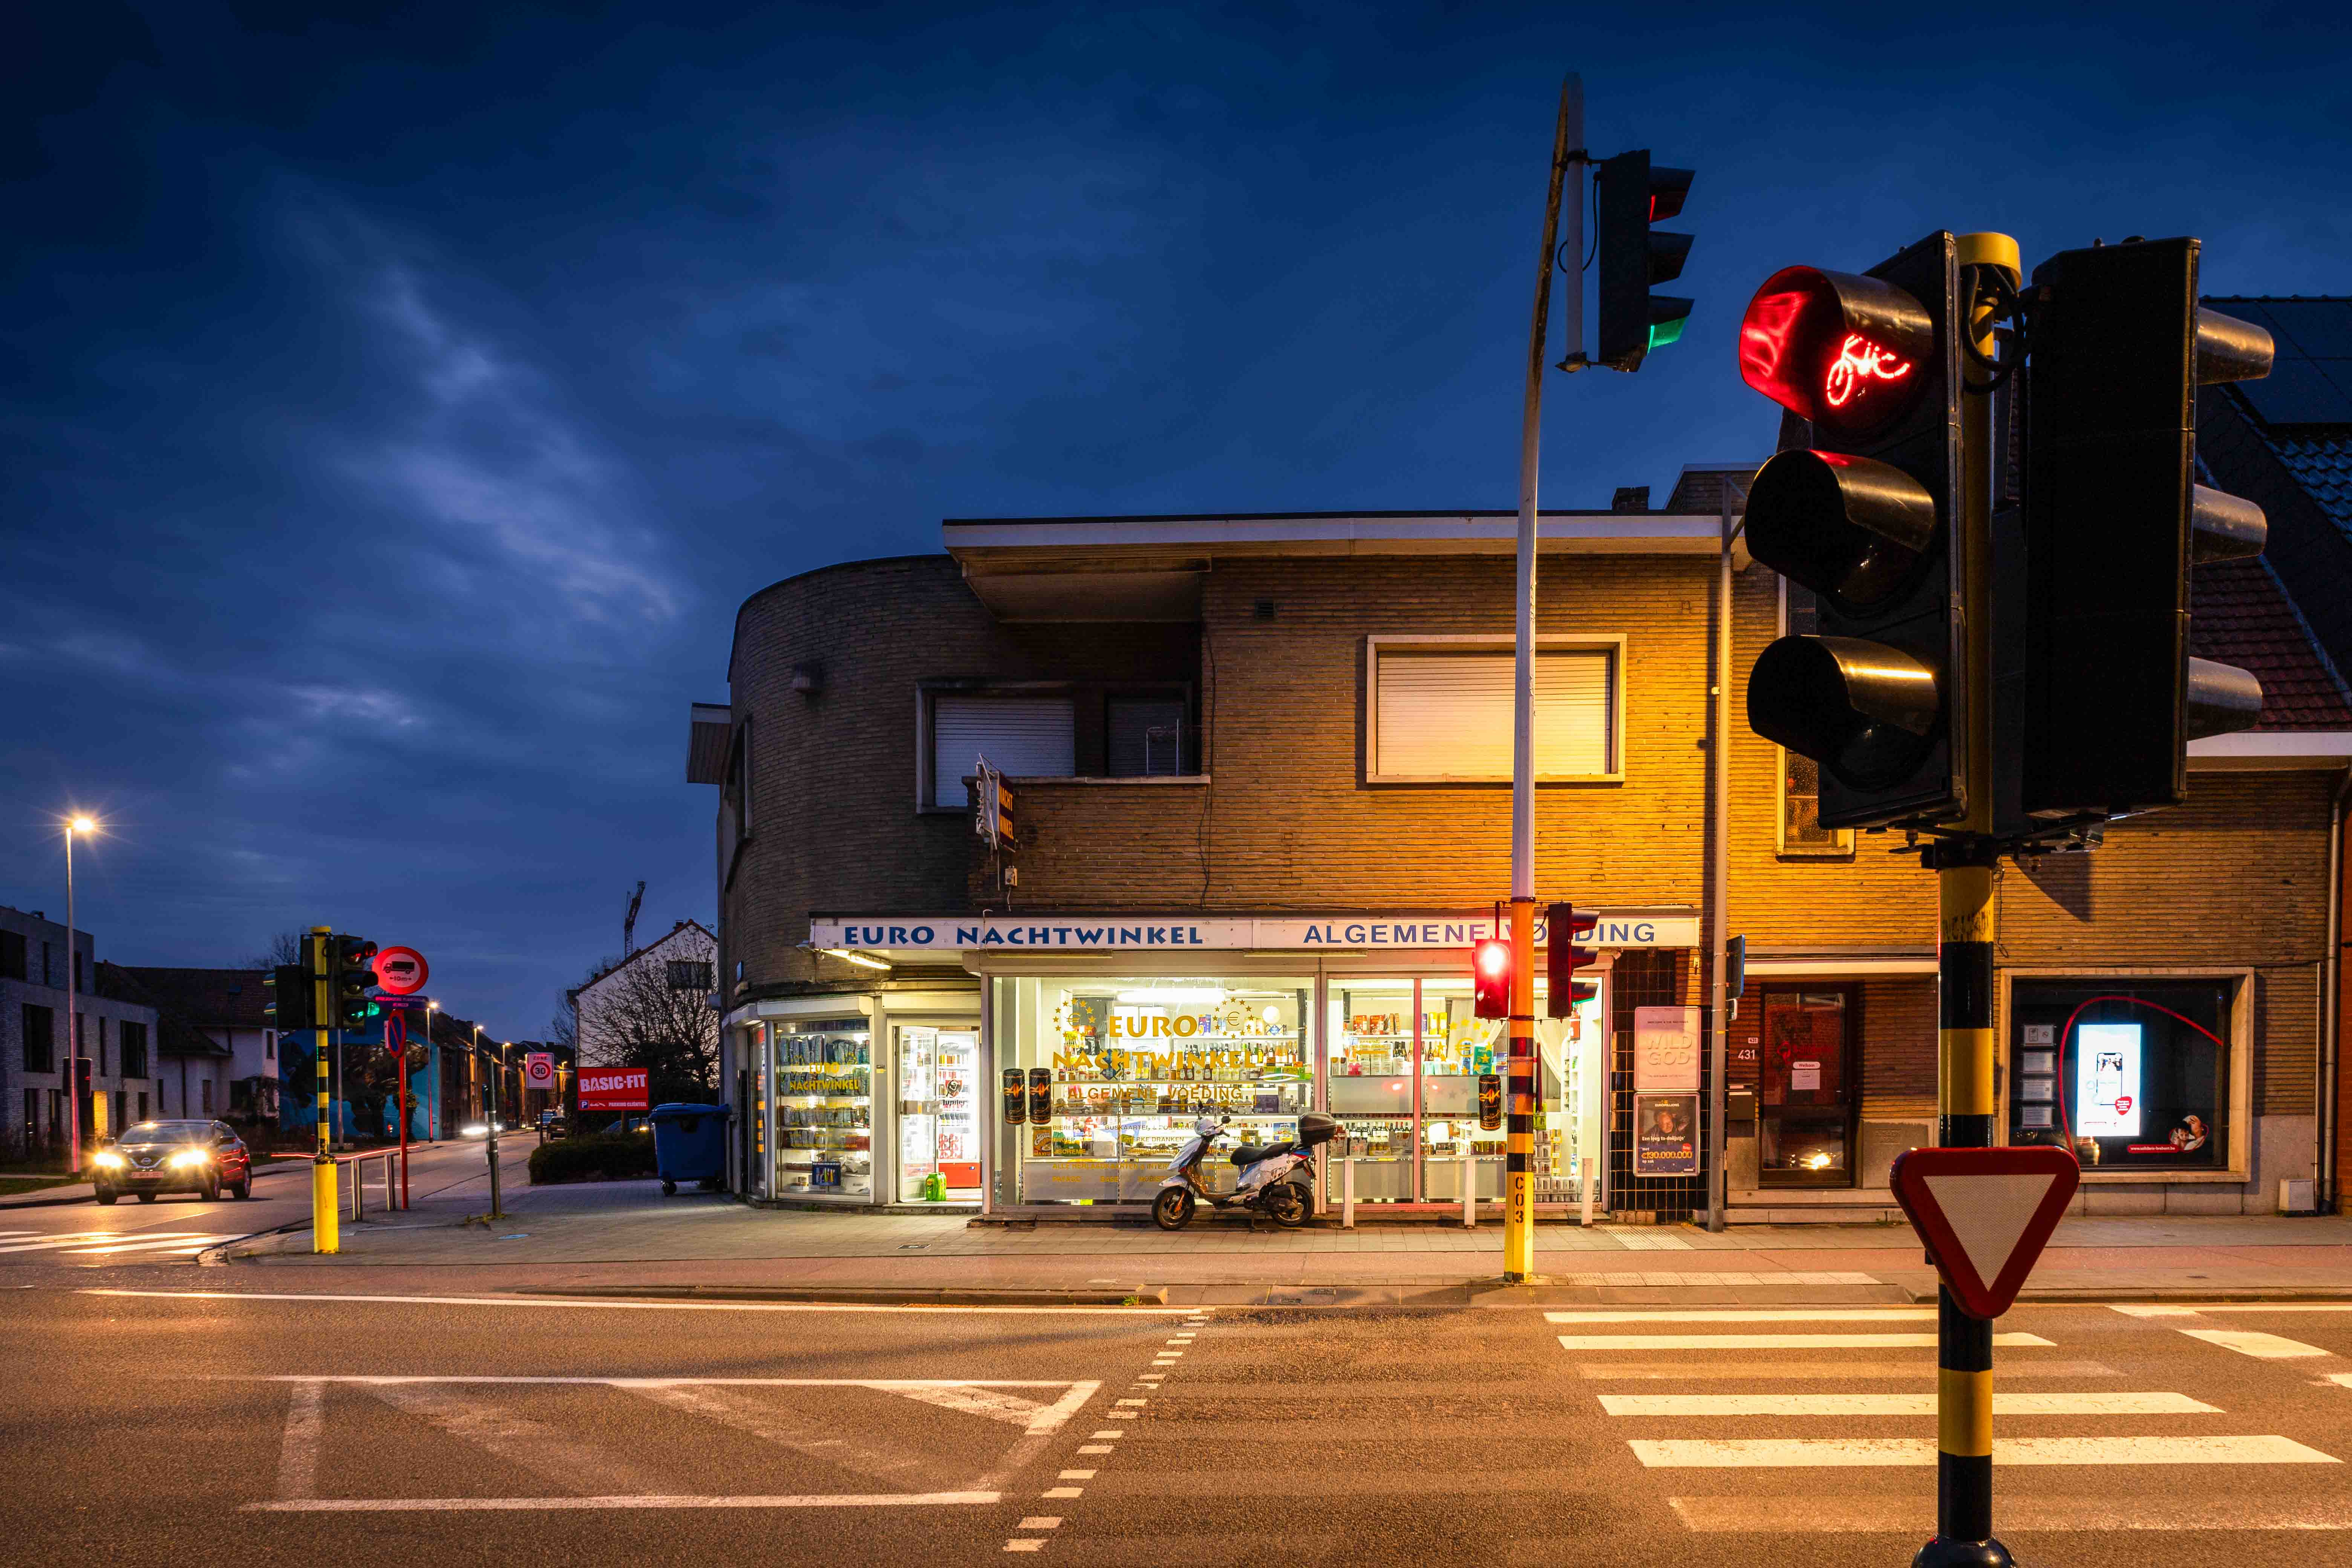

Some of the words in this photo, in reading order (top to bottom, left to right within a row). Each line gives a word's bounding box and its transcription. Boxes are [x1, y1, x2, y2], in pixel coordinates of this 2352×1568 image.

[999, 784, 1013, 812] NACHT
[999, 814, 1014, 840] WINKEL
[844, 926, 935, 945] EURO
[957, 926, 1202, 945] NACHTWINKEL
[1303, 924, 1485, 943] ALGEMENE
[1505, 923, 1654, 942] ODING
[1109, 1015, 1197, 1037] EURO
[1648, 1035, 1692, 1049] WILD
[1053, 1051, 1256, 1069] NACHTWINKEL
[1648, 1052, 1690, 1065] GOD
[1738, 1050, 1755, 1060] 431
[809, 1061, 839, 1074] EURO
[579, 1074, 646, 1092] BASIC-FIT
[790, 1079, 860, 1090] NACHTWINKEL
[1068, 1088, 1158, 1099] ALGEMENE
[1168, 1088, 1243, 1099] VOEDING
